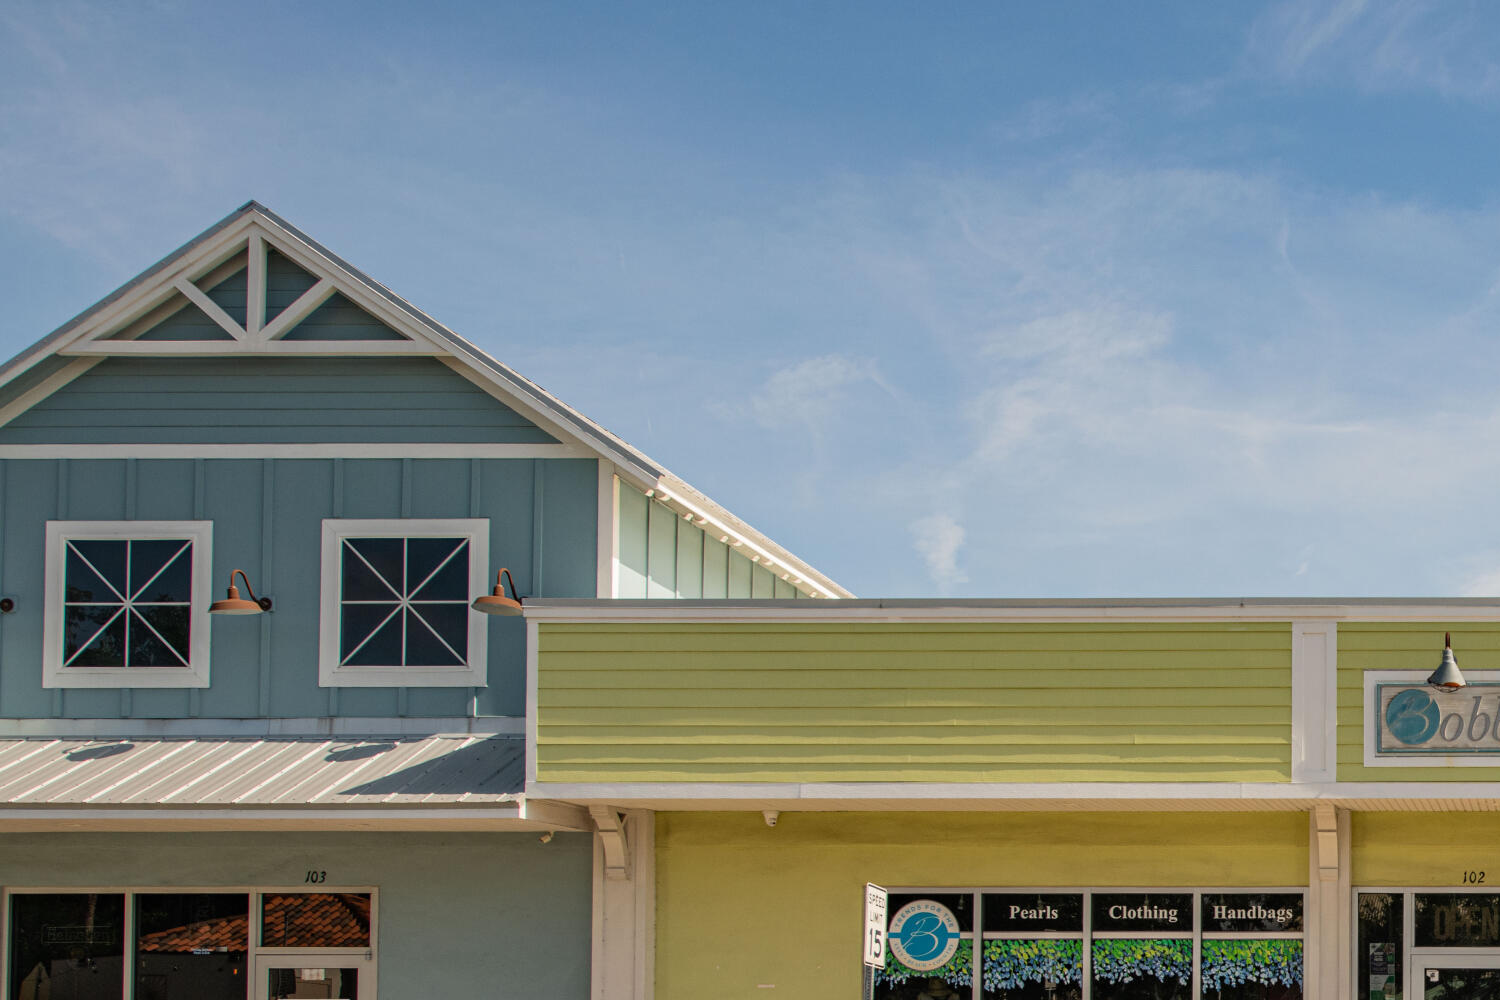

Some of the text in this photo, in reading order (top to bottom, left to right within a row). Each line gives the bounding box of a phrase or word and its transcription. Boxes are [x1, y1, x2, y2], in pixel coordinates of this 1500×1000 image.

[305, 870, 327, 883] 103
[1463, 871, 1485, 884] 102
[868, 892, 885, 909] SPEED
[869, 910, 884, 925] LIMIT
[1009, 905, 1059, 920] Pearls
[1109, 905, 1179, 922] Clothing
[1213, 905, 1293, 923] Handbags
[869, 928, 882, 958] 15
